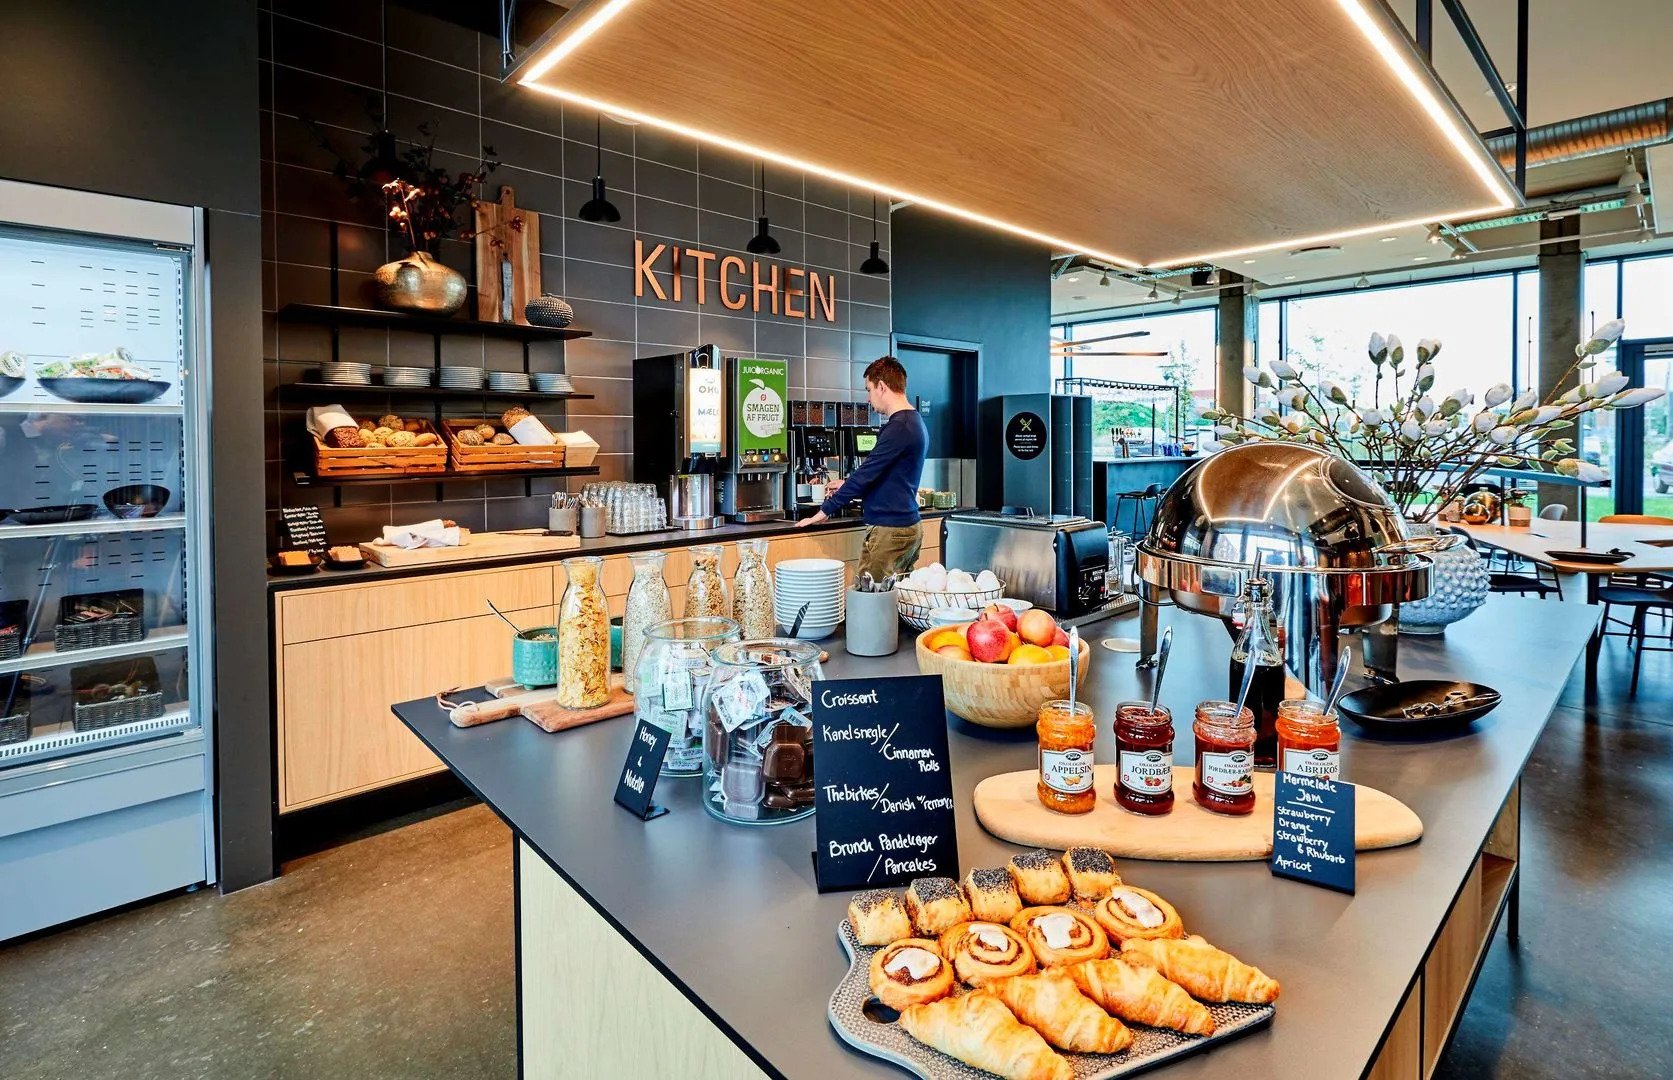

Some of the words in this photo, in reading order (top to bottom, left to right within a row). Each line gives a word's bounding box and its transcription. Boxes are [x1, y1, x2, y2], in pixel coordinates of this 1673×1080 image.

[634, 239, 835, 322] KITCHEN
[746, 403, 780, 413] SMAGEN
[746, 413, 756, 421] AF
[757, 413, 780, 422] FRUGT
[821, 689, 879, 708] Croissant
[640, 725, 658, 752] Honey
[918, 760, 940, 773] Rolls
[1051, 764, 1092, 775] APPELSIN
[1131, 765, 1172, 776] JORDBÆR
[1296, 764, 1338, 775] ABRIKOS
[1296, 789, 1324, 804] Jam
[880, 797, 916, 814] Danish
[1277, 806, 1331, 827] Strawberry
[1278, 817, 1314, 834] Orange
[829, 840, 874, 858] Brunch
[1276, 830, 1328, 851] Strawberry
[1275, 854, 1312, 874] Apricot
[1307, 847, 1346, 865] Rhubarb
